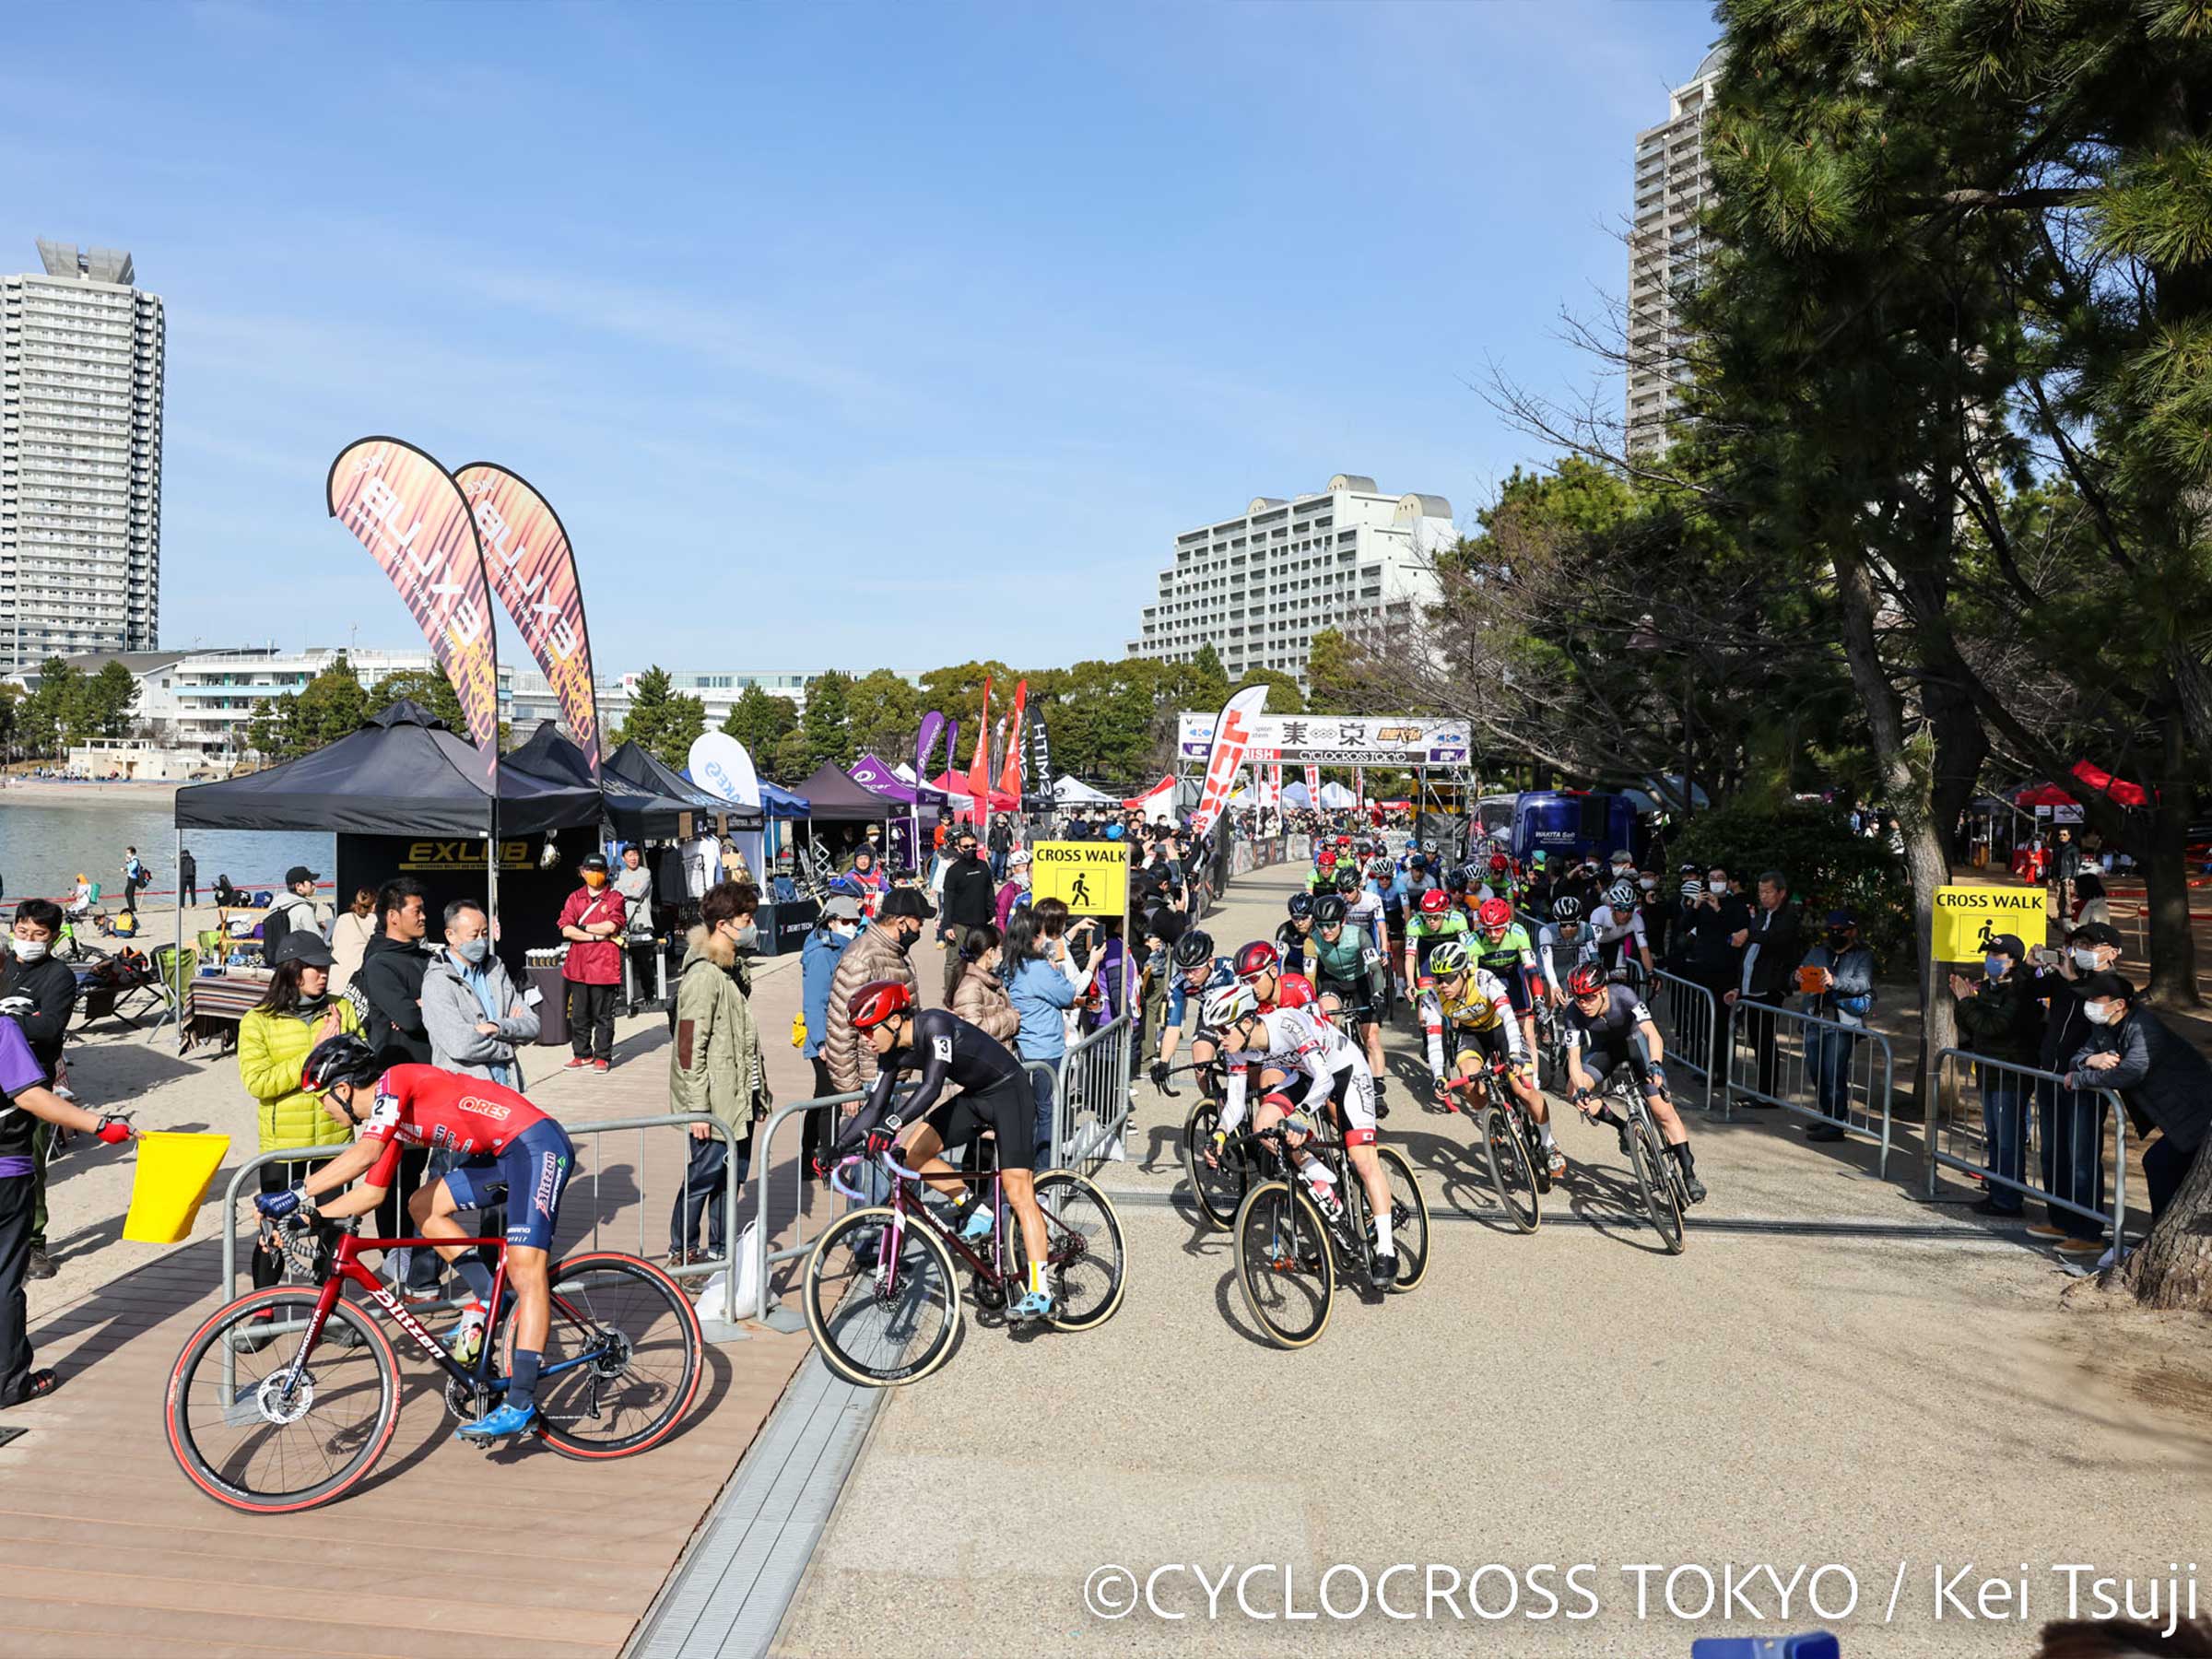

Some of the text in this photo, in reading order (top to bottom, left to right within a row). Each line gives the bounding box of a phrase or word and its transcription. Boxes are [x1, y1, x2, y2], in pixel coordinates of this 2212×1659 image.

[1281, 722, 1309, 745] 東
[1338, 723, 1366, 746] 京
[1300, 751, 1406, 762] CYCLOCROSS TOKYO
[1036, 848, 1126, 863] CROSS WALK
[1936, 893, 2043, 909] CROSS WALK
[1364, 948, 1376, 959] 14
[1567, 1031, 1573, 1043] 5
[940, 1039, 948, 1053] 3
[374, 1099, 385, 1115] 2
[459, 1097, 511, 1121] ORES
[370, 1288, 446, 1359] Blitzen
